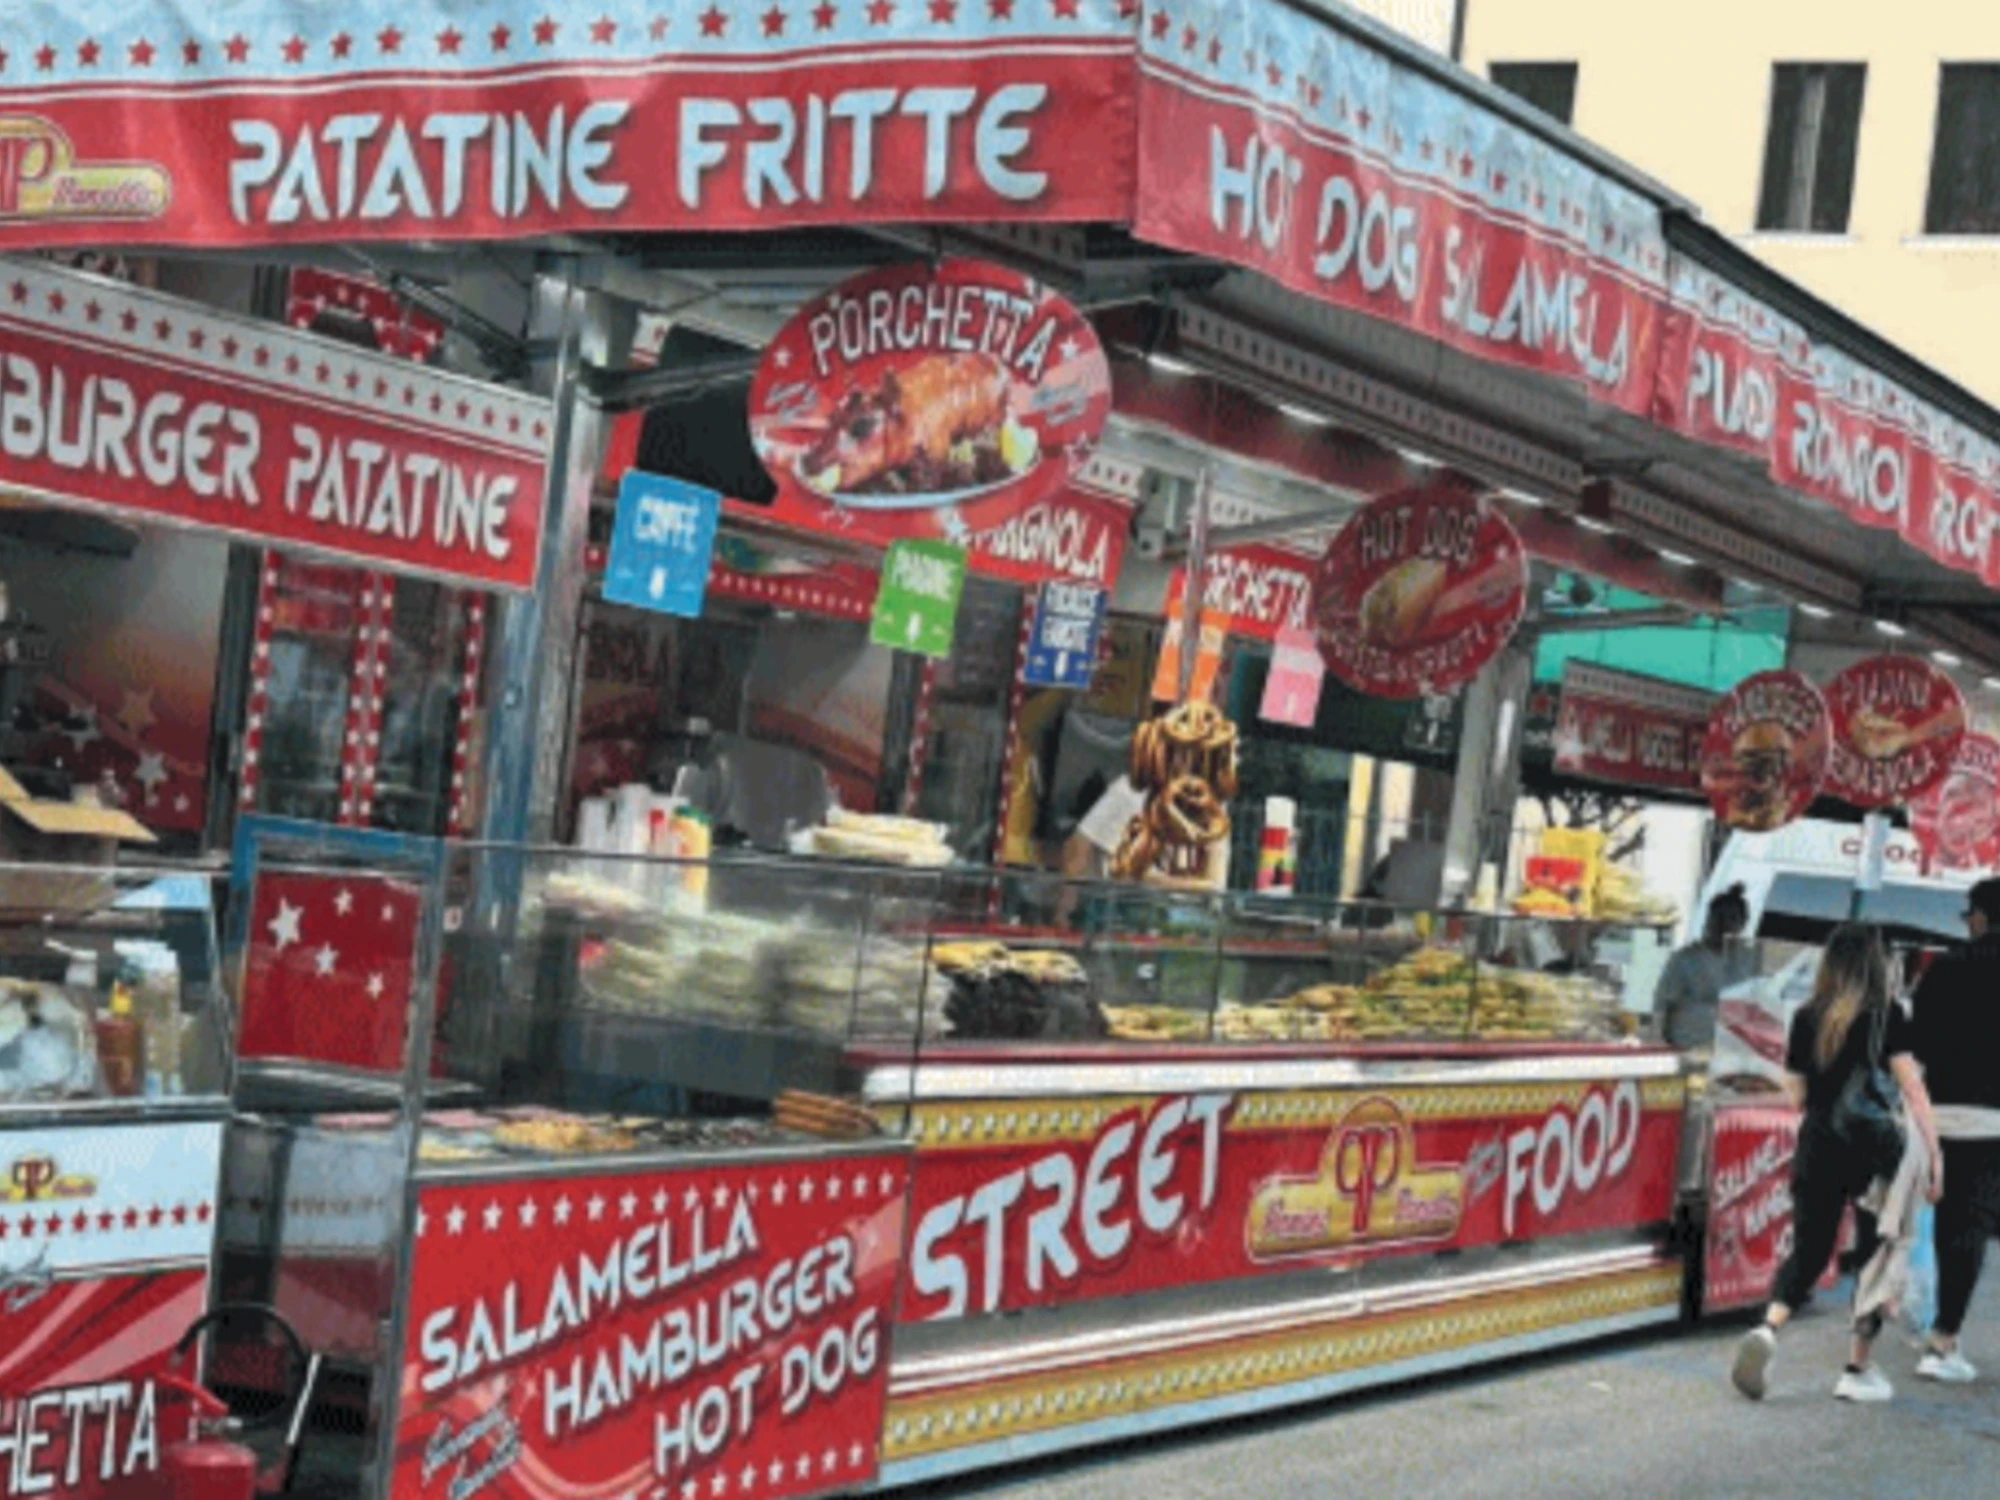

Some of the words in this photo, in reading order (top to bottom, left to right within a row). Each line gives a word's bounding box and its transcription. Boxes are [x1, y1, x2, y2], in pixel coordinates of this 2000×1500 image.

[228, 101, 632, 224] PATATINE
[677, 83, 1049, 209] FRITTE
[1313, 173, 1418, 302] DOG
[807, 282, 1059, 379] PORCHETTA
[285, 424, 519, 560] PATATINE
[911, 1092, 1238, 1320] STREET
[1502, 1080, 1641, 1237] FOOD
[421, 1191, 758, 1391] SALAMELLA
[544, 1234, 855, 1438] HAMBURGER
[655, 1362, 764, 1477] HOT
[780, 1305, 880, 1417] DOG
